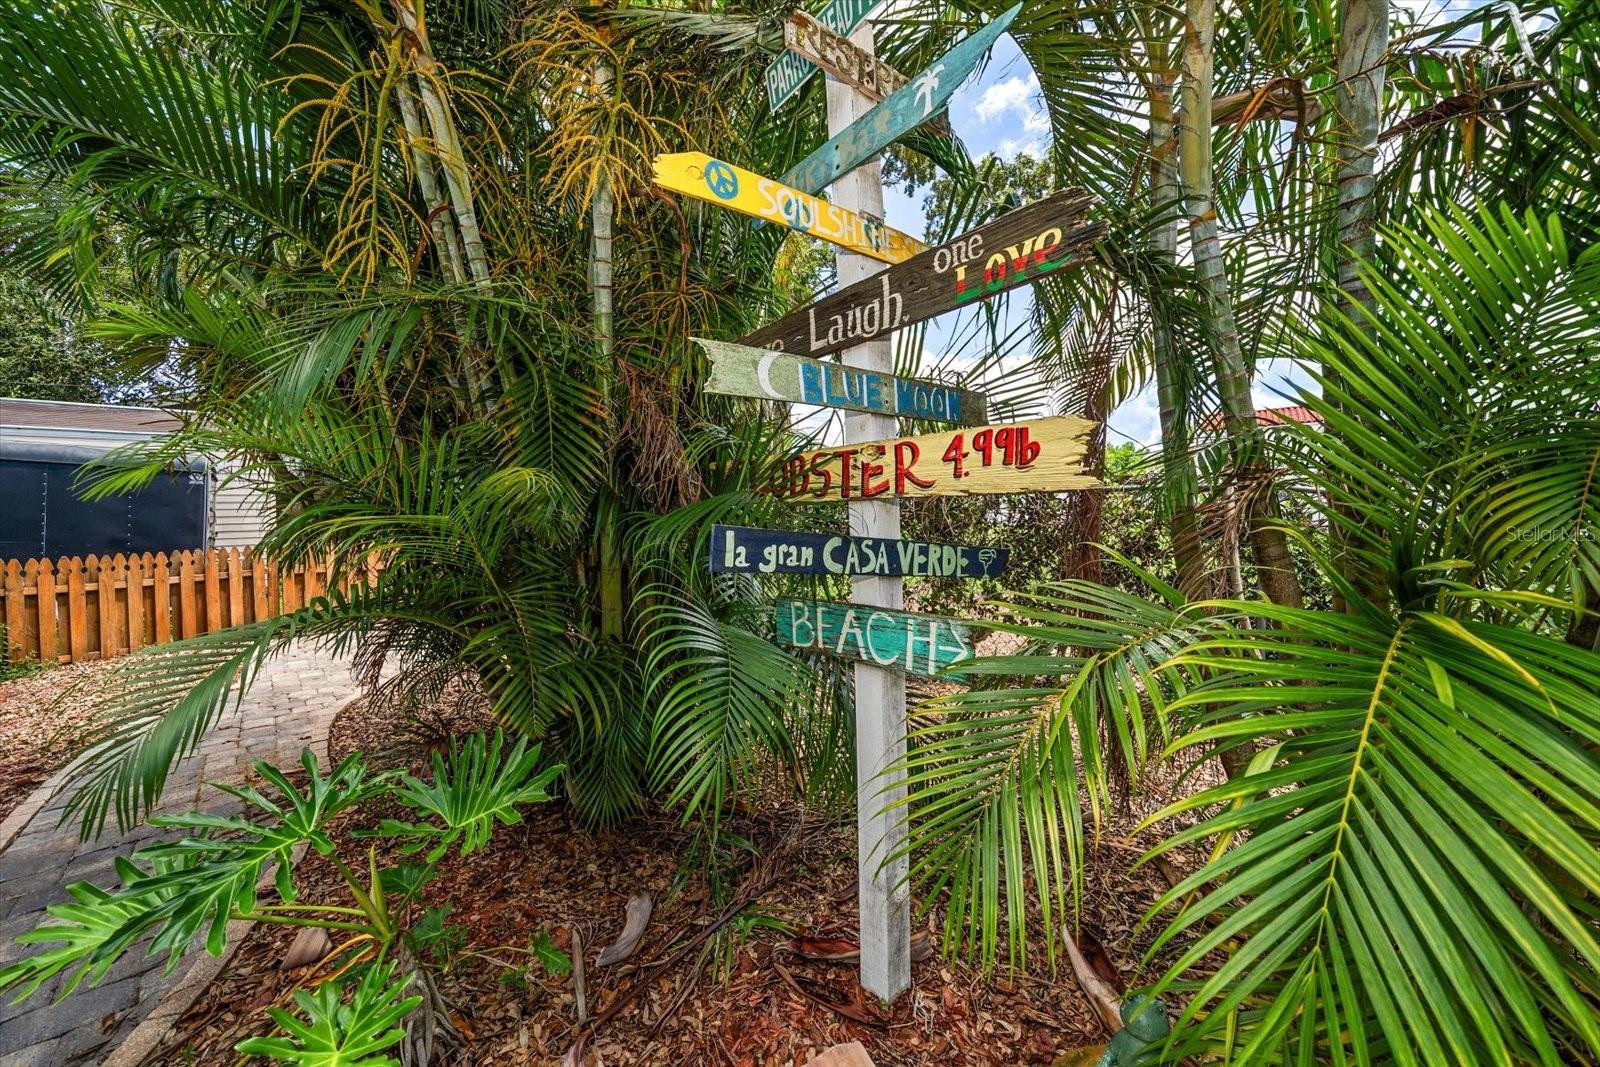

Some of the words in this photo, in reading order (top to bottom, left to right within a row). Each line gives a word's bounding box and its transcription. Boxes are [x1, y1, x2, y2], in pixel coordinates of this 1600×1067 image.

[808, 274, 904, 352] Laugh
[932, 233, 985, 274] one
[798, 362, 882, 409] BLUE
[894, 377, 961, 423] MOON
[756, 440, 937, 499] OBSTER
[724, 530, 750, 568] la
[758, 542, 814, 573] gran
[822, 536, 889, 574] CASA
[896, 540, 969, 577] VERDE
[790, 601, 938, 675] BEACH
